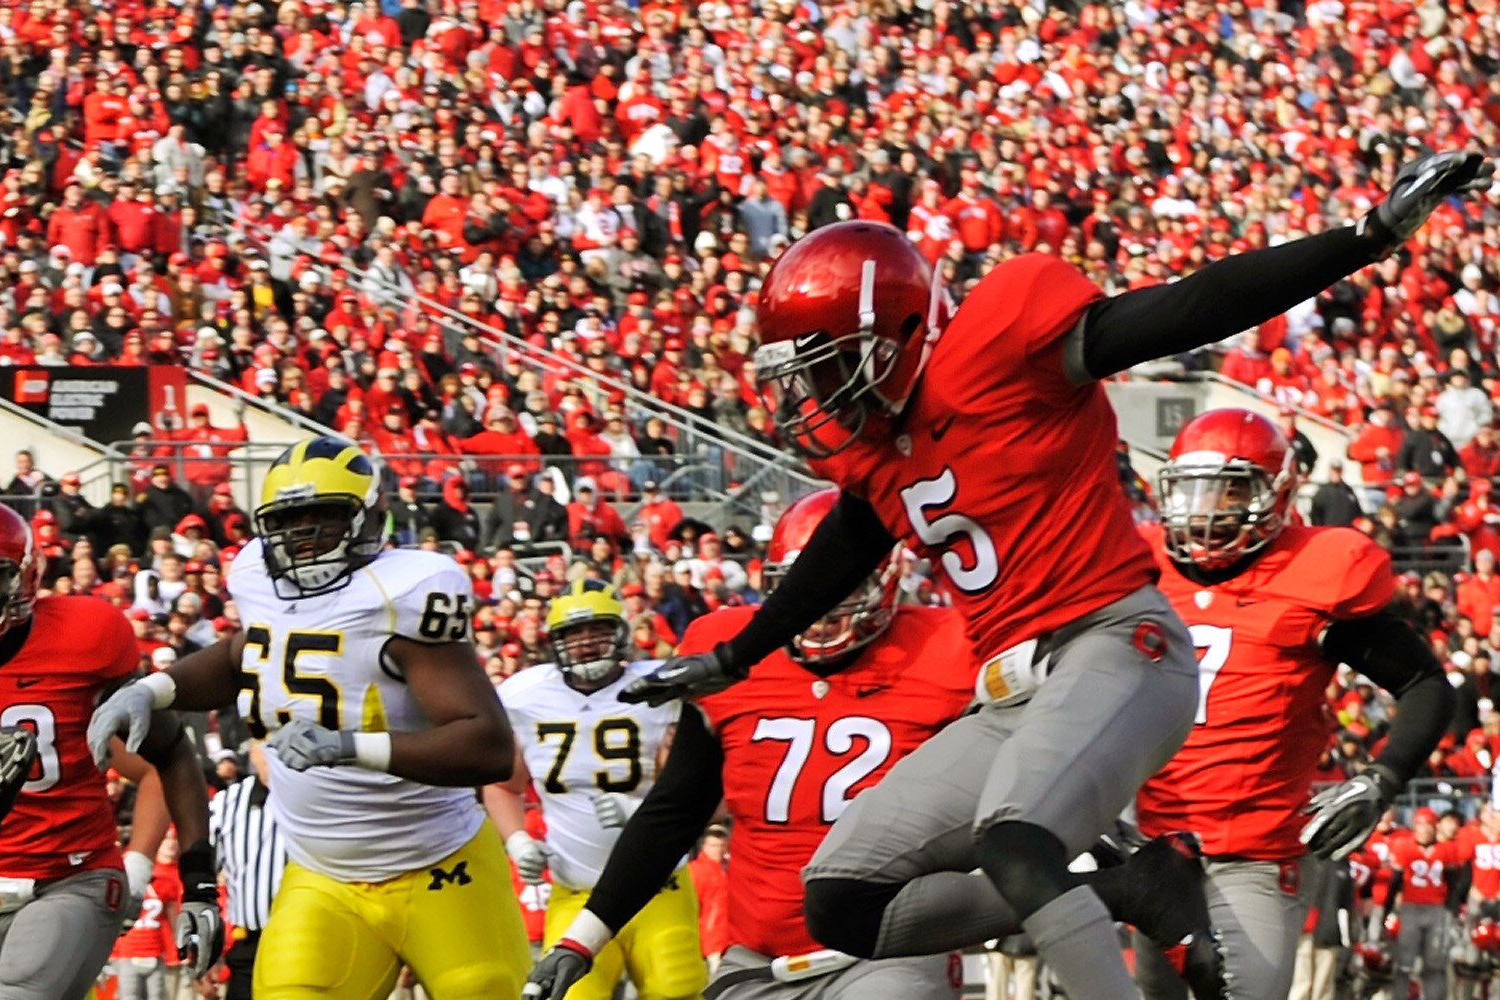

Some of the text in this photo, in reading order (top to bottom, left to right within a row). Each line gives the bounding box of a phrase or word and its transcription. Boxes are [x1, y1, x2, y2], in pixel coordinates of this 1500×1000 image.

[899, 466, 1000, 593] 5
[419, 592, 468, 639] 65
[238, 625, 342, 739] 65
[1188, 624, 1233, 725] 7
[535, 717, 643, 794] 79
[750, 714, 892, 823] 72
[134, 898, 164, 929] 2
[428, 861, 472, 890] M
